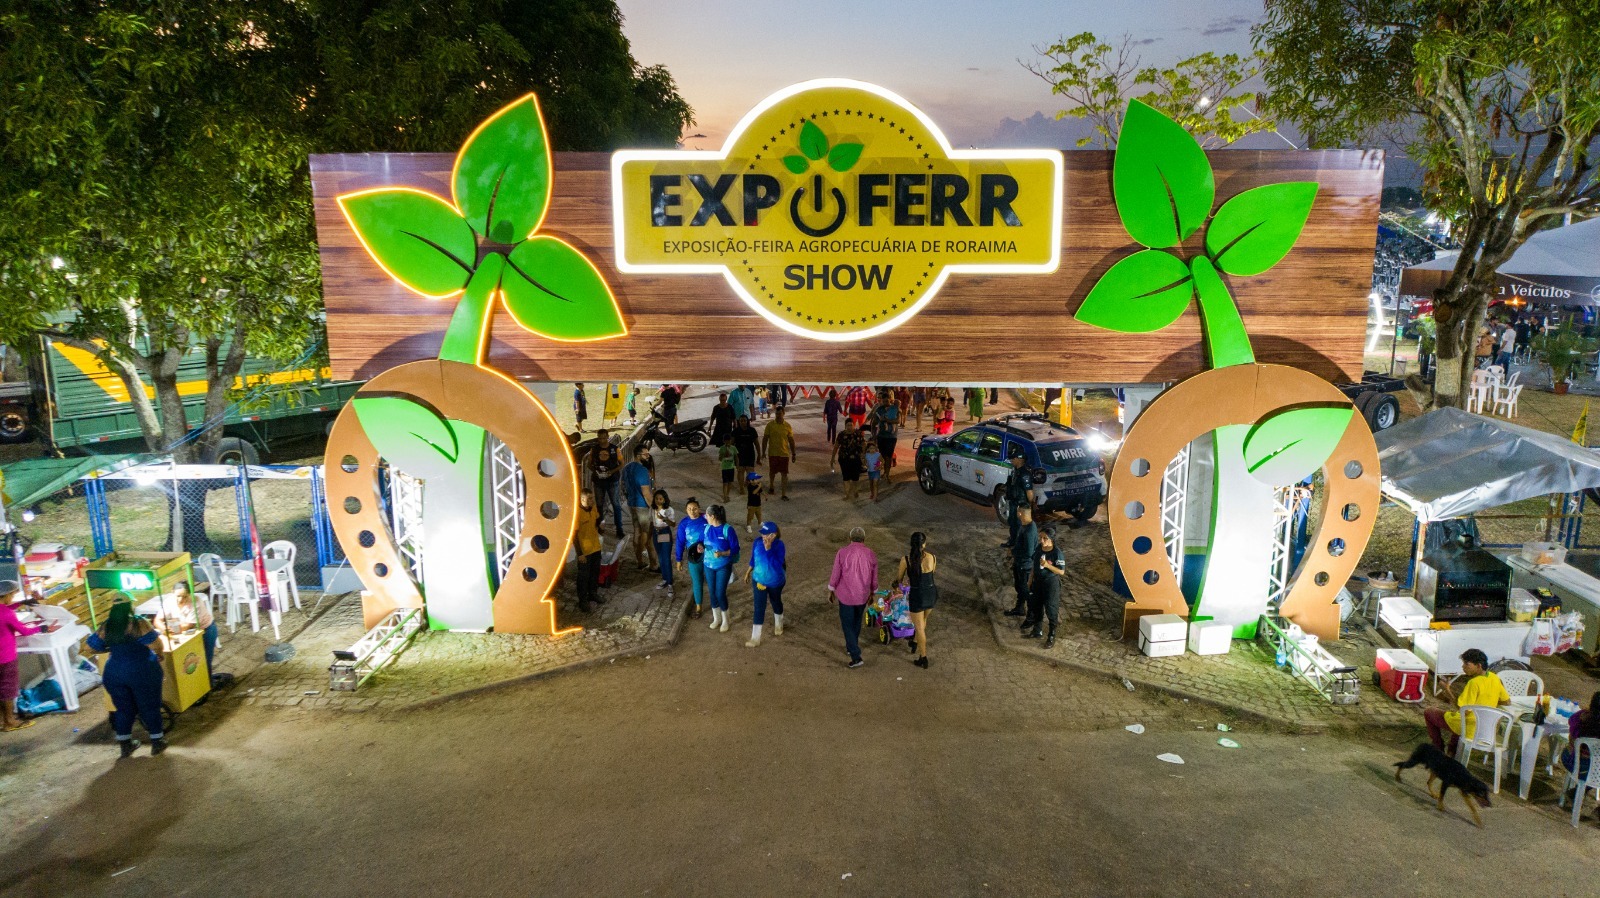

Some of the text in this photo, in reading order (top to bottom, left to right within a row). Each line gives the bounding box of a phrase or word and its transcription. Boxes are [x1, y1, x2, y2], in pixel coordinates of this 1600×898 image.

[663, 237, 1017, 257] EXPOSIÇÃO-FEIRA AGROPECUÁRIA DE RORAIMA
[783, 263, 893, 290] SHOW
[1510, 284, 1571, 299] Veículos
[1052, 447, 1086, 461] PMRR
